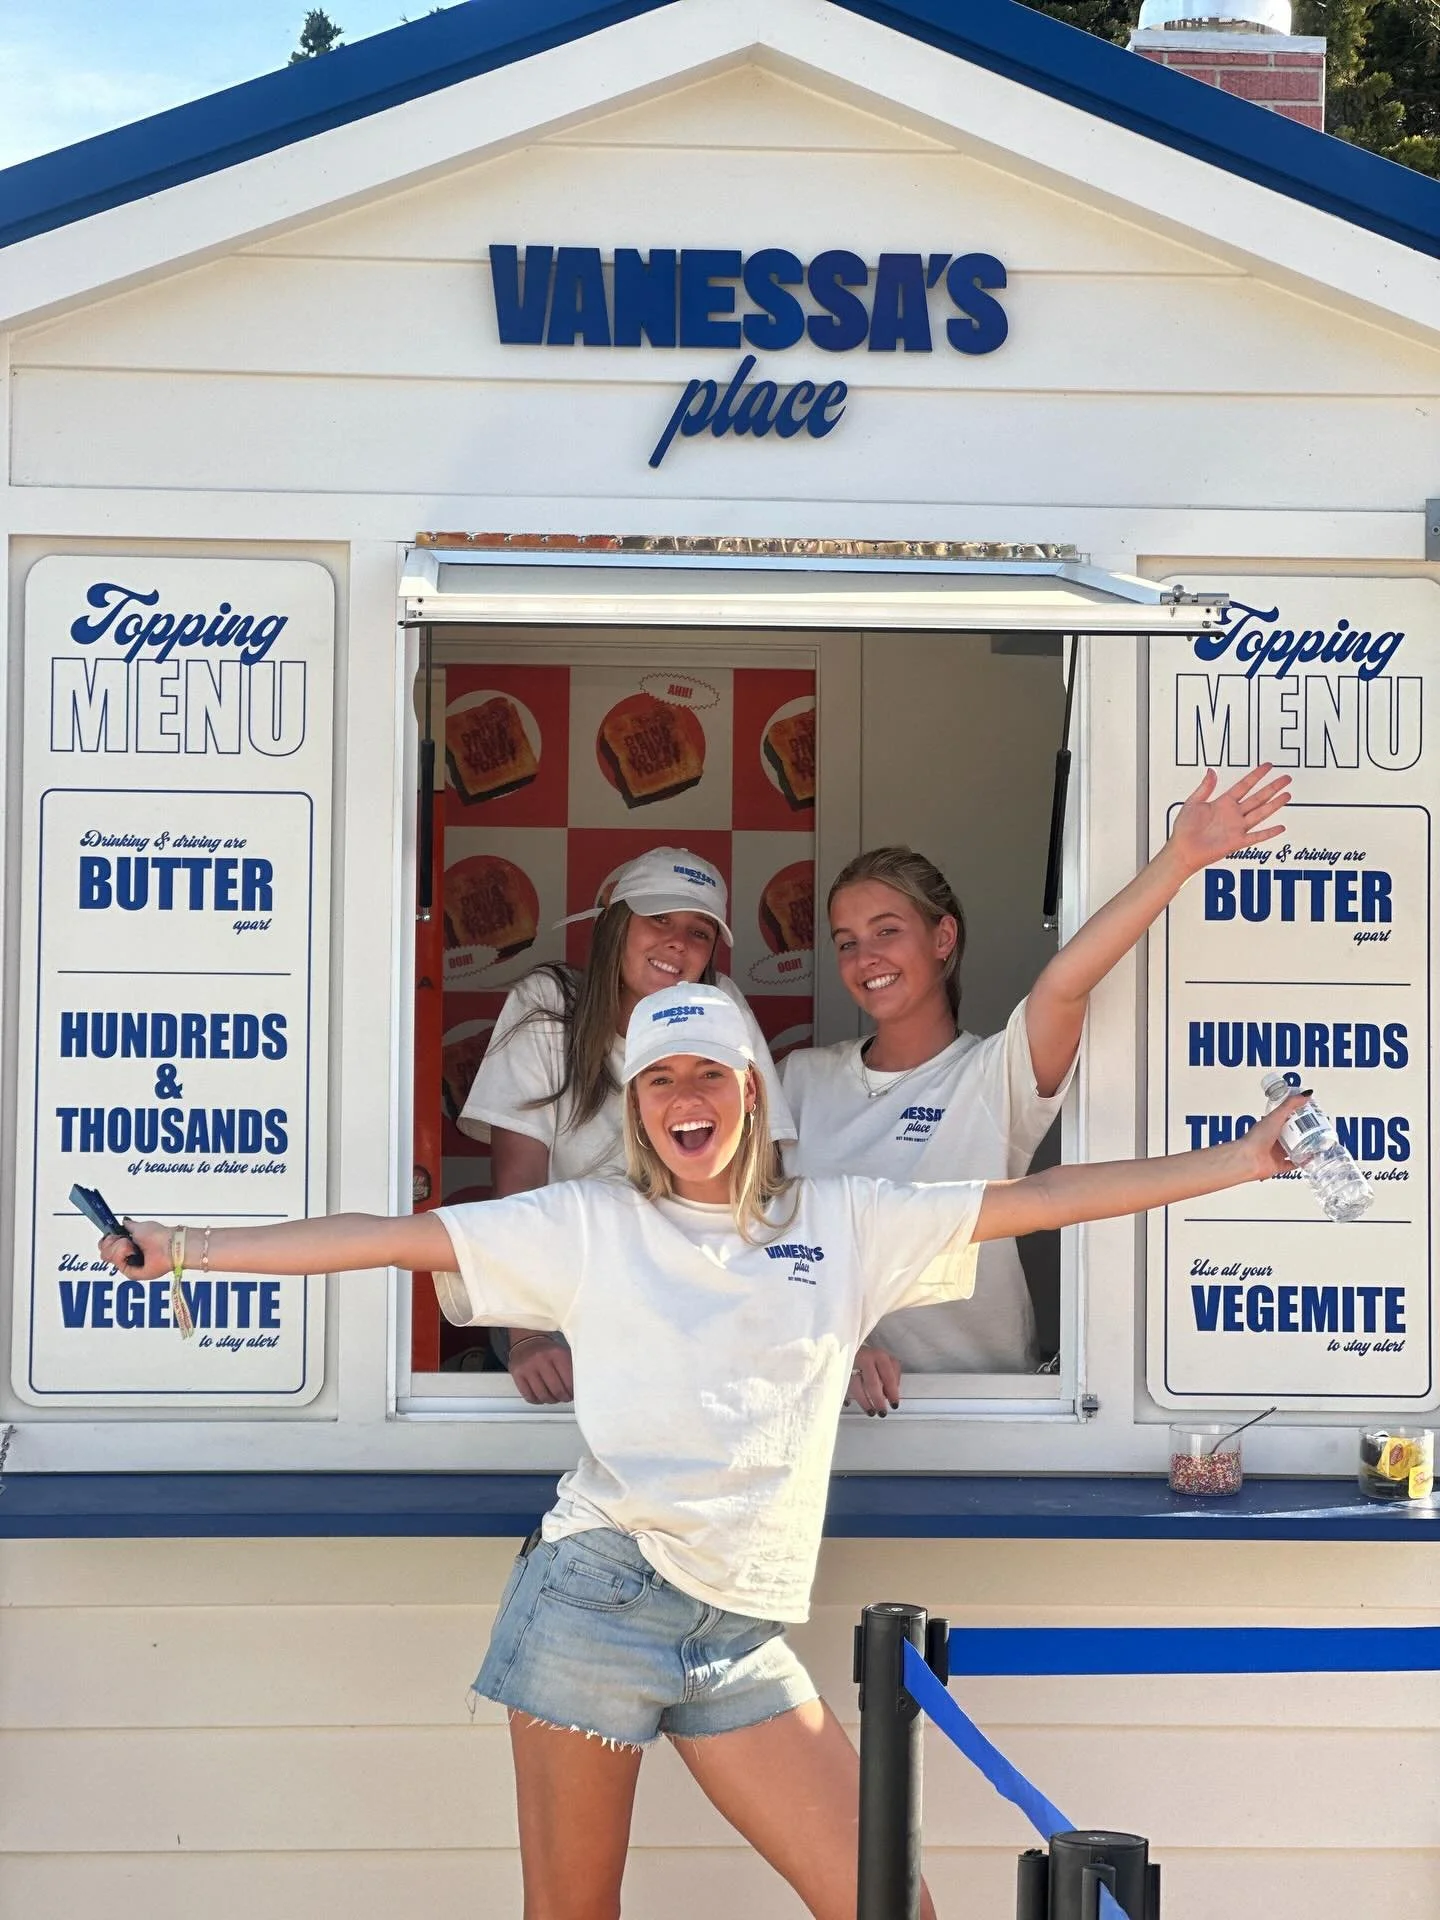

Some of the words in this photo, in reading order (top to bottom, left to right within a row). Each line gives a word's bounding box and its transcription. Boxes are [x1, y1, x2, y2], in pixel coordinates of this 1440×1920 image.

[489, 245, 1008, 355] VANESSA'S
[648, 354, 848, 468] place
[70, 583, 288, 666] Topping
[1194, 600, 1405, 681] Topping
[51, 657, 307, 756] MENU
[1176, 673, 1422, 771] MENU
[80, 830, 149, 852] Drinking
[154, 832, 170, 850] &
[173, 835, 221, 853] driving
[223, 838, 247, 848] are
[1225, 847, 1272, 864] inking
[1276, 844, 1291, 863] &
[1294, 848, 1341, 865] driving
[1343, 851, 1367, 861] are
[79, 856, 273, 911] BUTTER
[1205, 869, 1392, 922] BUTTER
[233, 919, 272, 935] apart
[1354, 930, 1391, 946] apart
[60, 1011, 287, 1060] HUNDREDS
[1189, 1022, 1408, 1069] HUNDREDS
[155, 1063, 183, 1099] &
[56, 1107, 288, 1154] THOUSANDS
[903, 1120, 931, 1135] place
[1185, 1115, 1410, 1162] THONDS
[128, 1160, 143, 1175] of
[145, 1161, 194, 1173] reasons
[197, 1161, 210, 1173] to
[213, 1161, 248, 1173] drive
[251, 1160, 287, 1173] sober
[1375, 1167, 1410, 1181] sober
[58, 1254, 88, 1271] Use
[1190, 1259, 1219, 1276] Use
[1221, 1263, 1241, 1276] all
[1241, 1266, 1273, 1281] your
[58, 1280, 280, 1330] VEGEMITE
[1191, 1285, 1406, 1333] VEGEMITE
[199, 1335, 212, 1347] to
[216, 1336, 244, 1352] stay
[246, 1335, 280, 1347] alert
[1327, 1339, 1340, 1351] to
[1343, 1339, 1371, 1356] stay
[1373, 1339, 1406, 1352] alert
